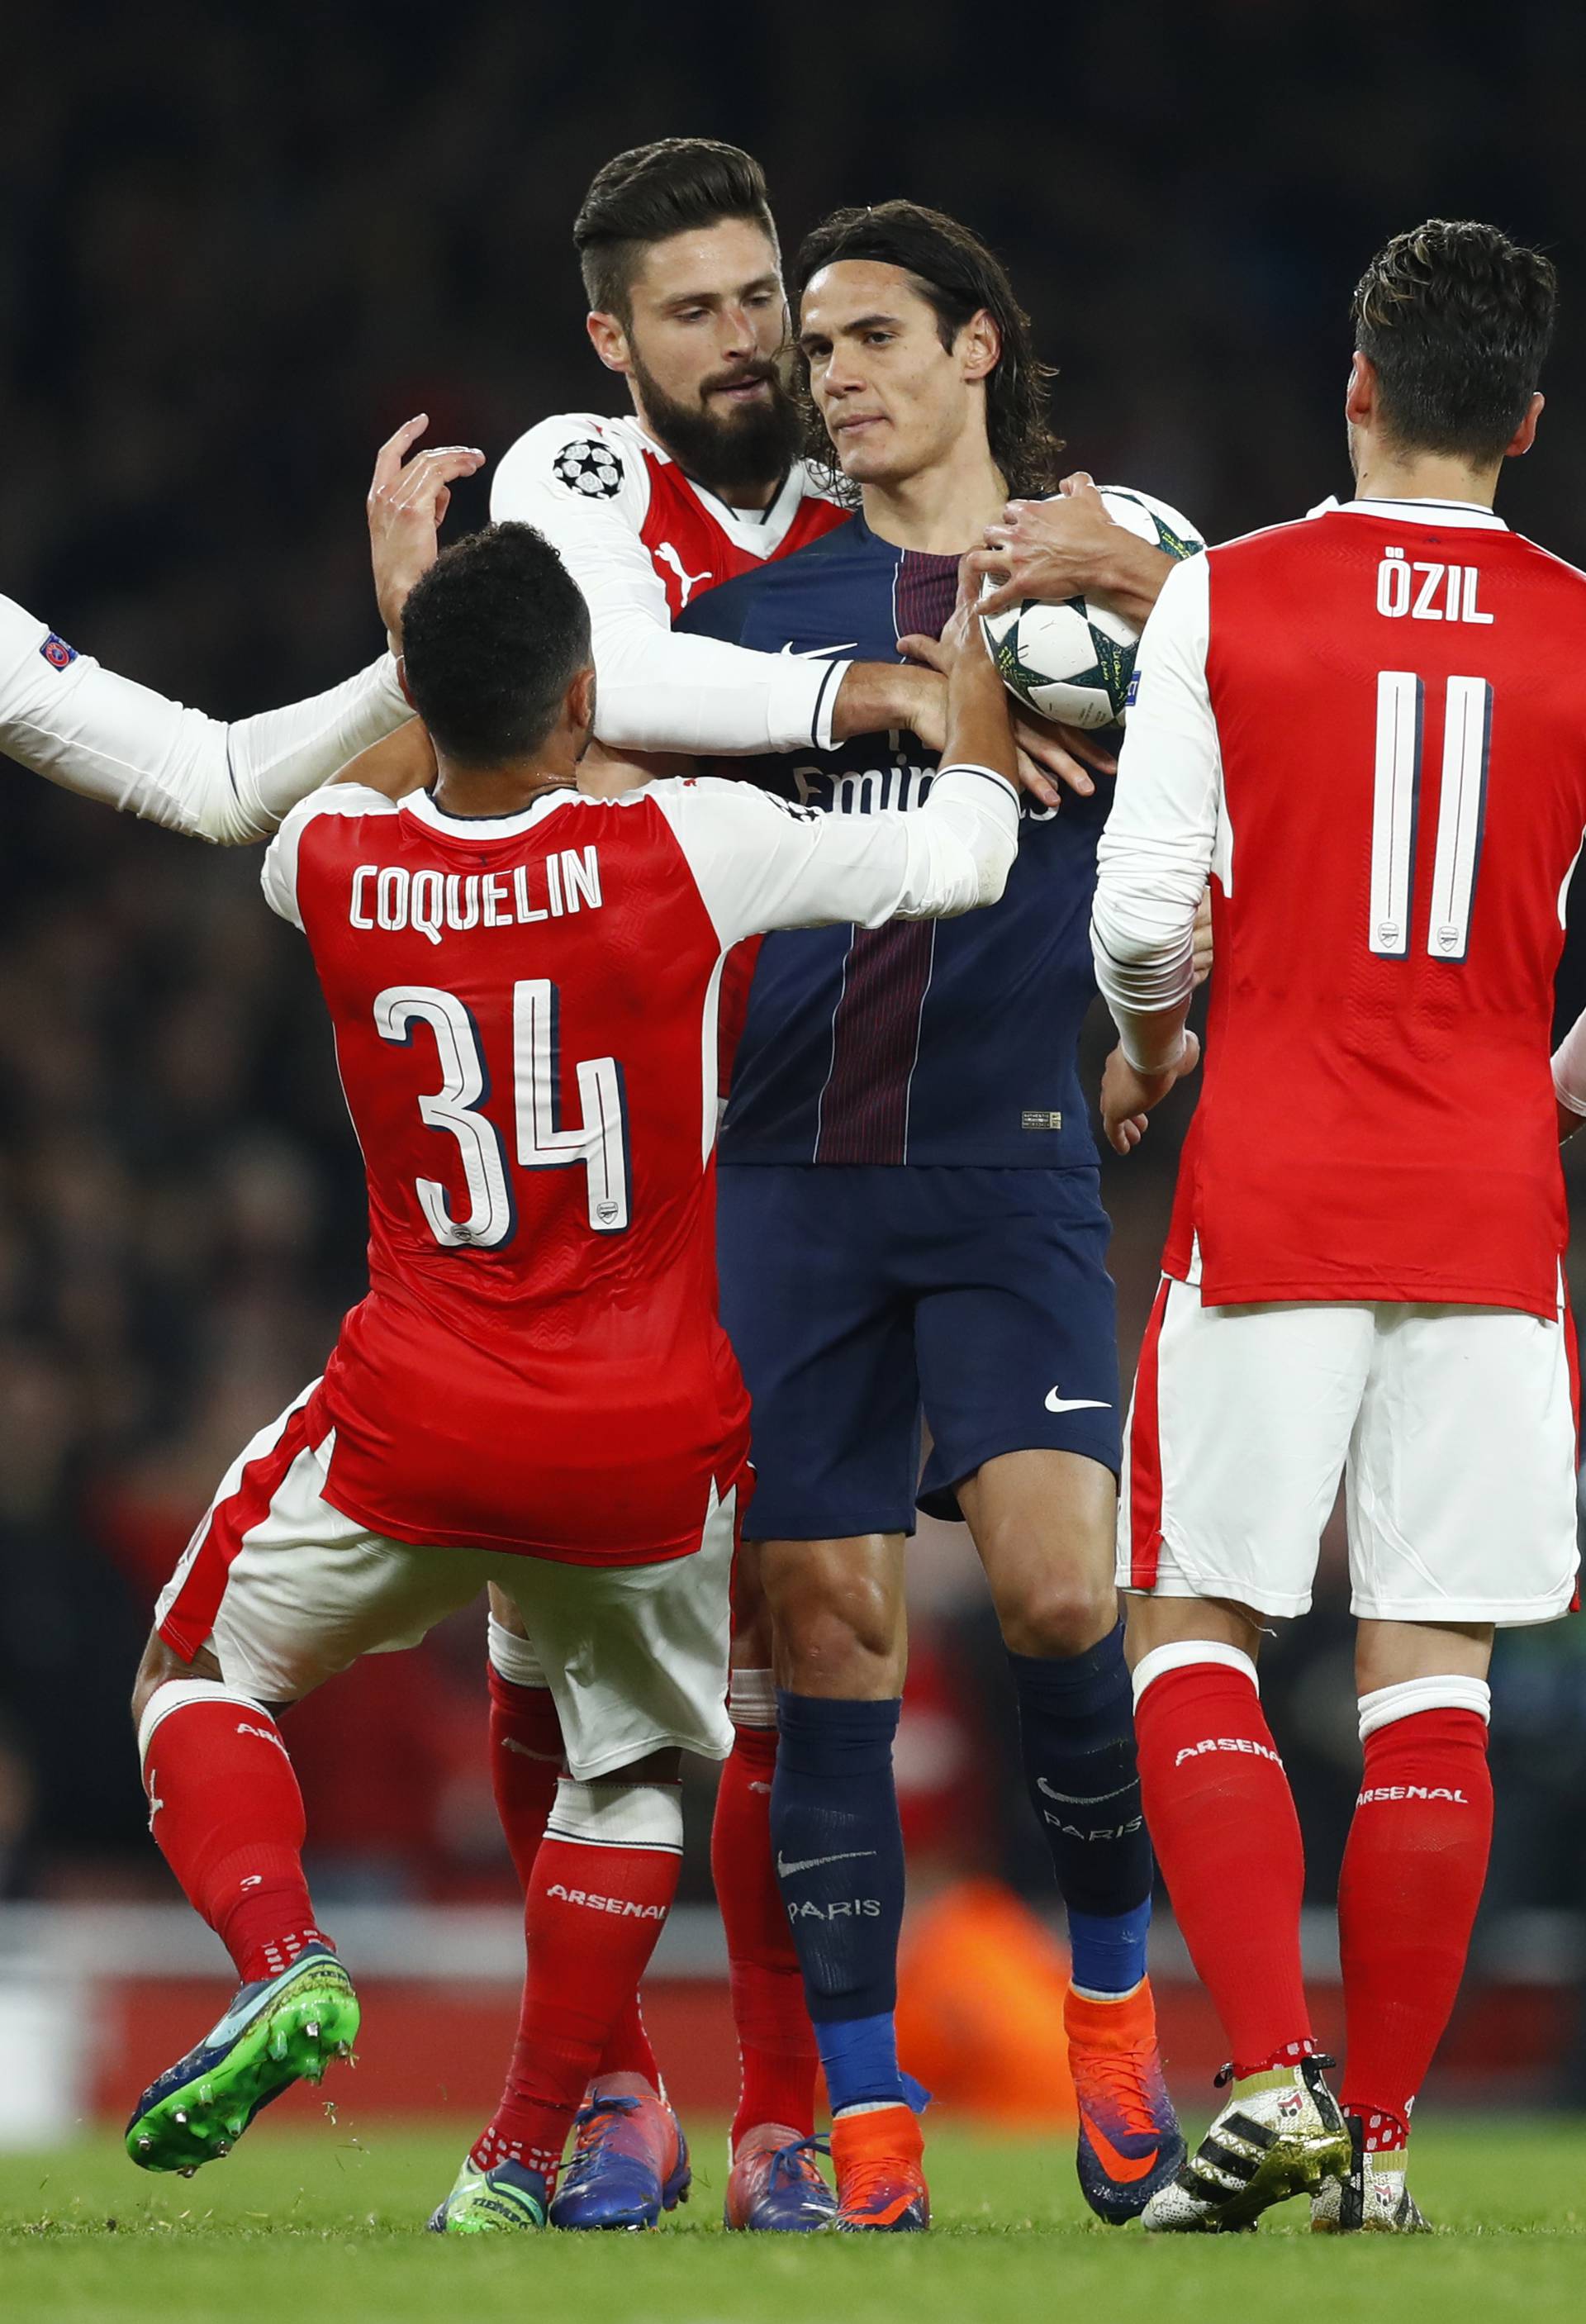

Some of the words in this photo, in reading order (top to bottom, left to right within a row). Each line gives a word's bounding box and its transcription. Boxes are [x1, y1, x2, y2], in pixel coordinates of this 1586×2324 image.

[1376, 546, 1494, 625] ÖZIL
[1369, 671, 1493, 962] 11
[349, 845, 603, 945] COQUELIN
[373, 978, 634, 1250] 34
[1043, 1809, 1143, 1842] PARIS
[1356, 1785, 1469, 1809] ARSENAL
[786, 1899, 881, 1924] PARIS
